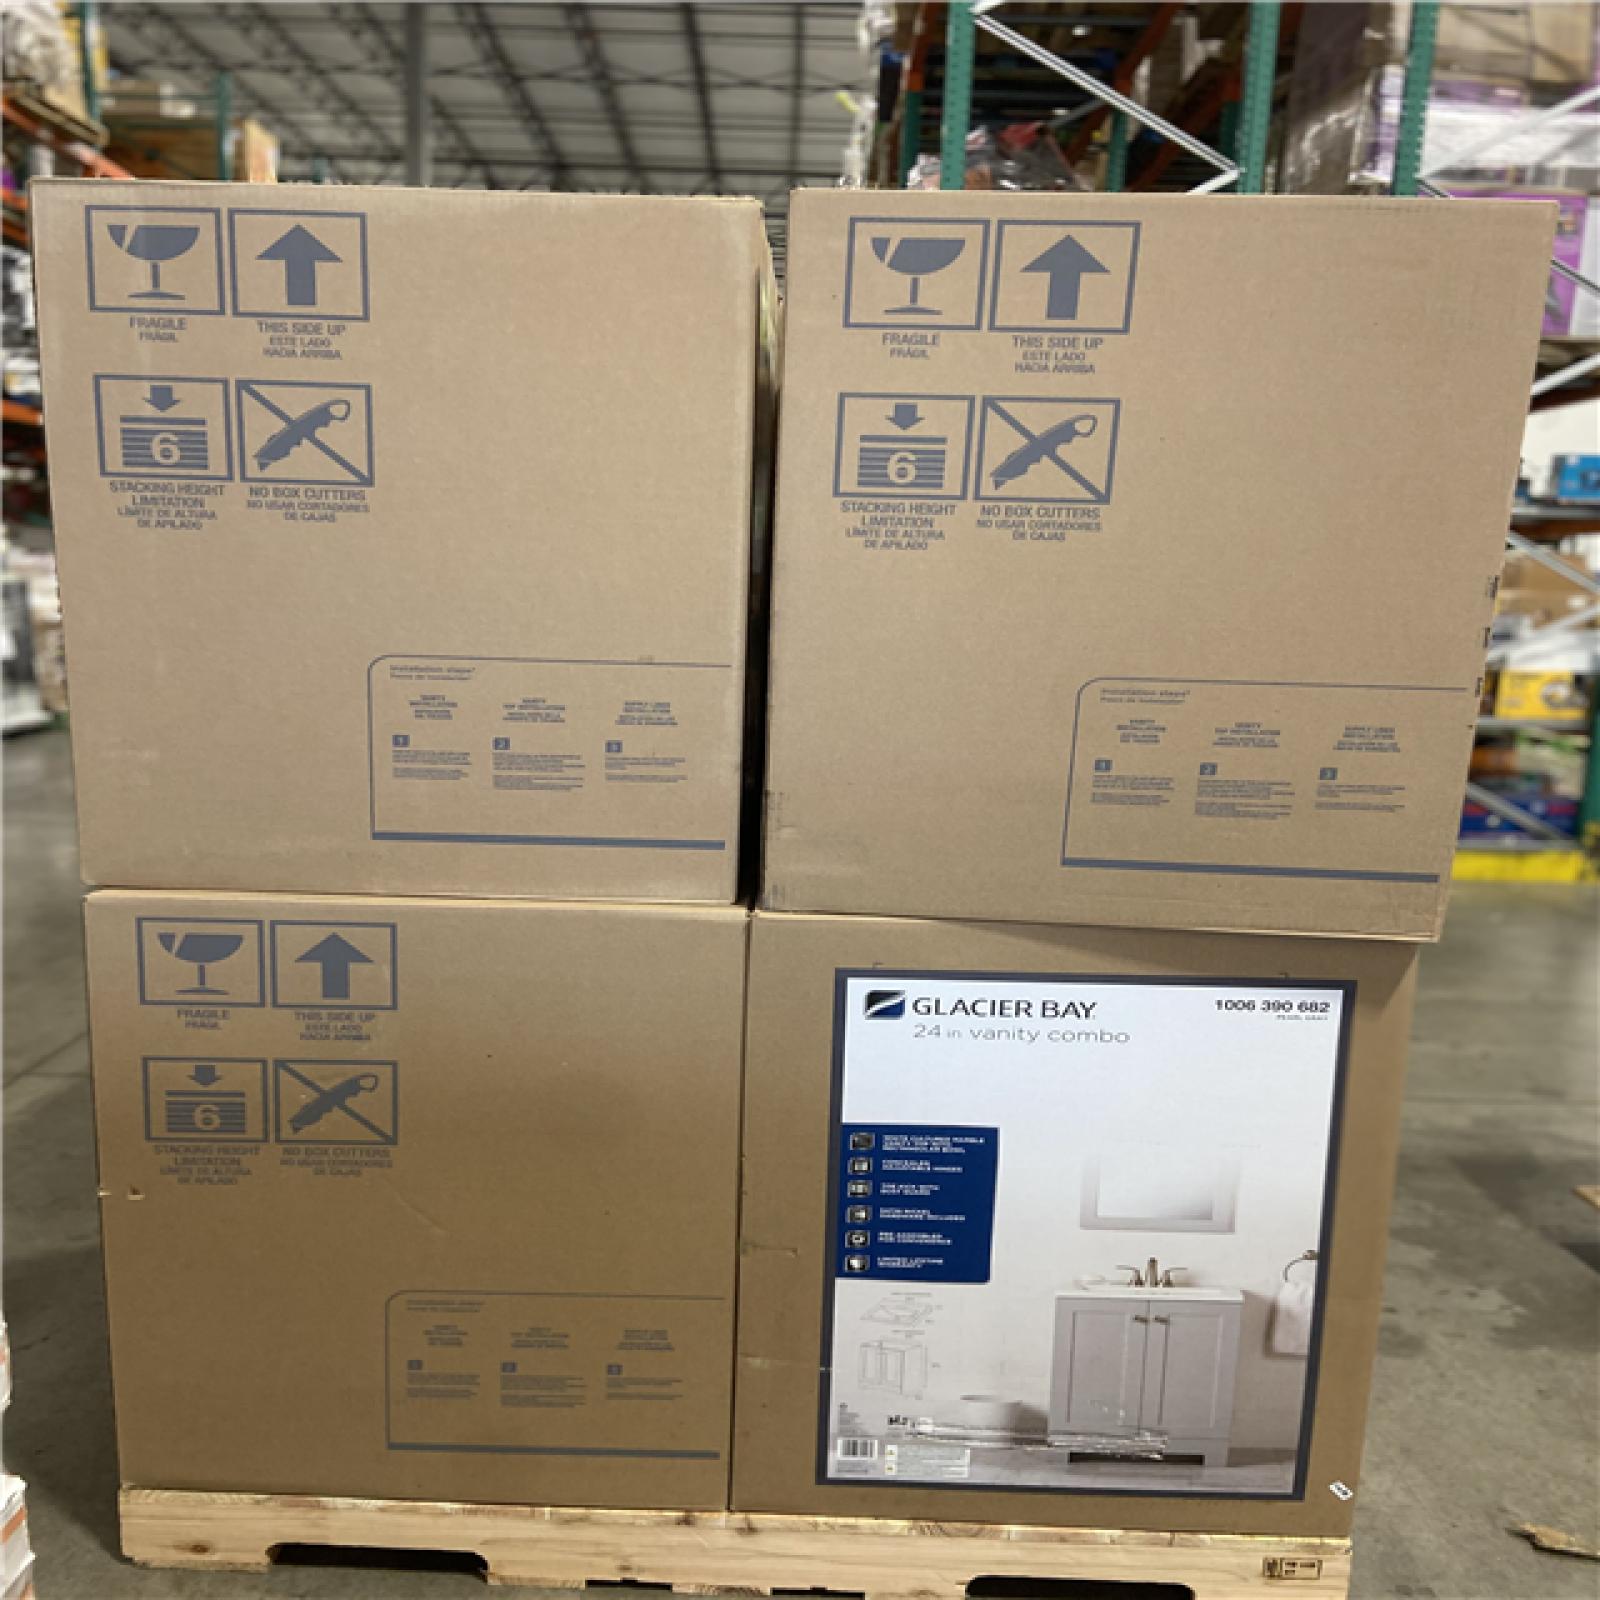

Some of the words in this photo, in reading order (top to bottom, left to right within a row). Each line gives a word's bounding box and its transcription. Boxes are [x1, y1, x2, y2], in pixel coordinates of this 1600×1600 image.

[129, 316, 187, 330] FRAGILE
[257, 320, 288, 333] THIS
[292, 322, 323, 335] SIDE
[327, 324, 346, 335] UP
[269, 336, 296, 346] ESTE
[300, 337, 331, 347] LADO
[882, 332, 940, 346] FRAGILE
[1012, 335, 1043, 348] THIS
[1047, 337, 1080, 349] SIDE
[1084, 337, 1103, 349] UP
[1022, 351, 1050, 361] ESTE
[1054, 352, 1086, 361] LADO
[150, 432, 180, 465] 6
[886, 451, 917, 484] 6
[109, 480, 175, 493] STACKING
[177, 484, 224, 495] HEIGHT
[249, 487, 270, 498] NO
[273, 487, 300, 499] BOX
[304, 488, 366, 501] CUTTERS
[131, 494, 205, 508] LIMITATION
[247, 499, 262, 508] NO
[841, 501, 906, 513] STACKING
[910, 502, 956, 515] HEIGHT
[284, 511, 297, 521] DE
[980, 504, 1000, 516] NO
[1004, 504, 1032, 517] BOX
[1037, 506, 1101, 519] CUTTERS
[862, 514, 934, 528] LIMITATION
[976, 519, 993, 528] NO
[1012, 531, 1025, 540] DE
[912, 997, 1032, 1017] GLACIER
[1041, 1000, 1096, 1019] BAY
[1215, 999, 1256, 1012] 1006
[1260, 999, 1294, 1013] 390
[1297, 1001, 1331, 1013] 682
[177, 1009, 230, 1020] FRAGILE
[295, 1011, 323, 1021] THIS
[327, 1012, 354, 1022] SIDE
[359, 1012, 376, 1022] UP
[913, 1024, 942, 1039] 24
[947, 1029, 961, 1039] in
[969, 1027, 1040, 1043] vanity
[1047, 1028, 1132, 1043] combo
[193, 1104, 221, 1130] 6
